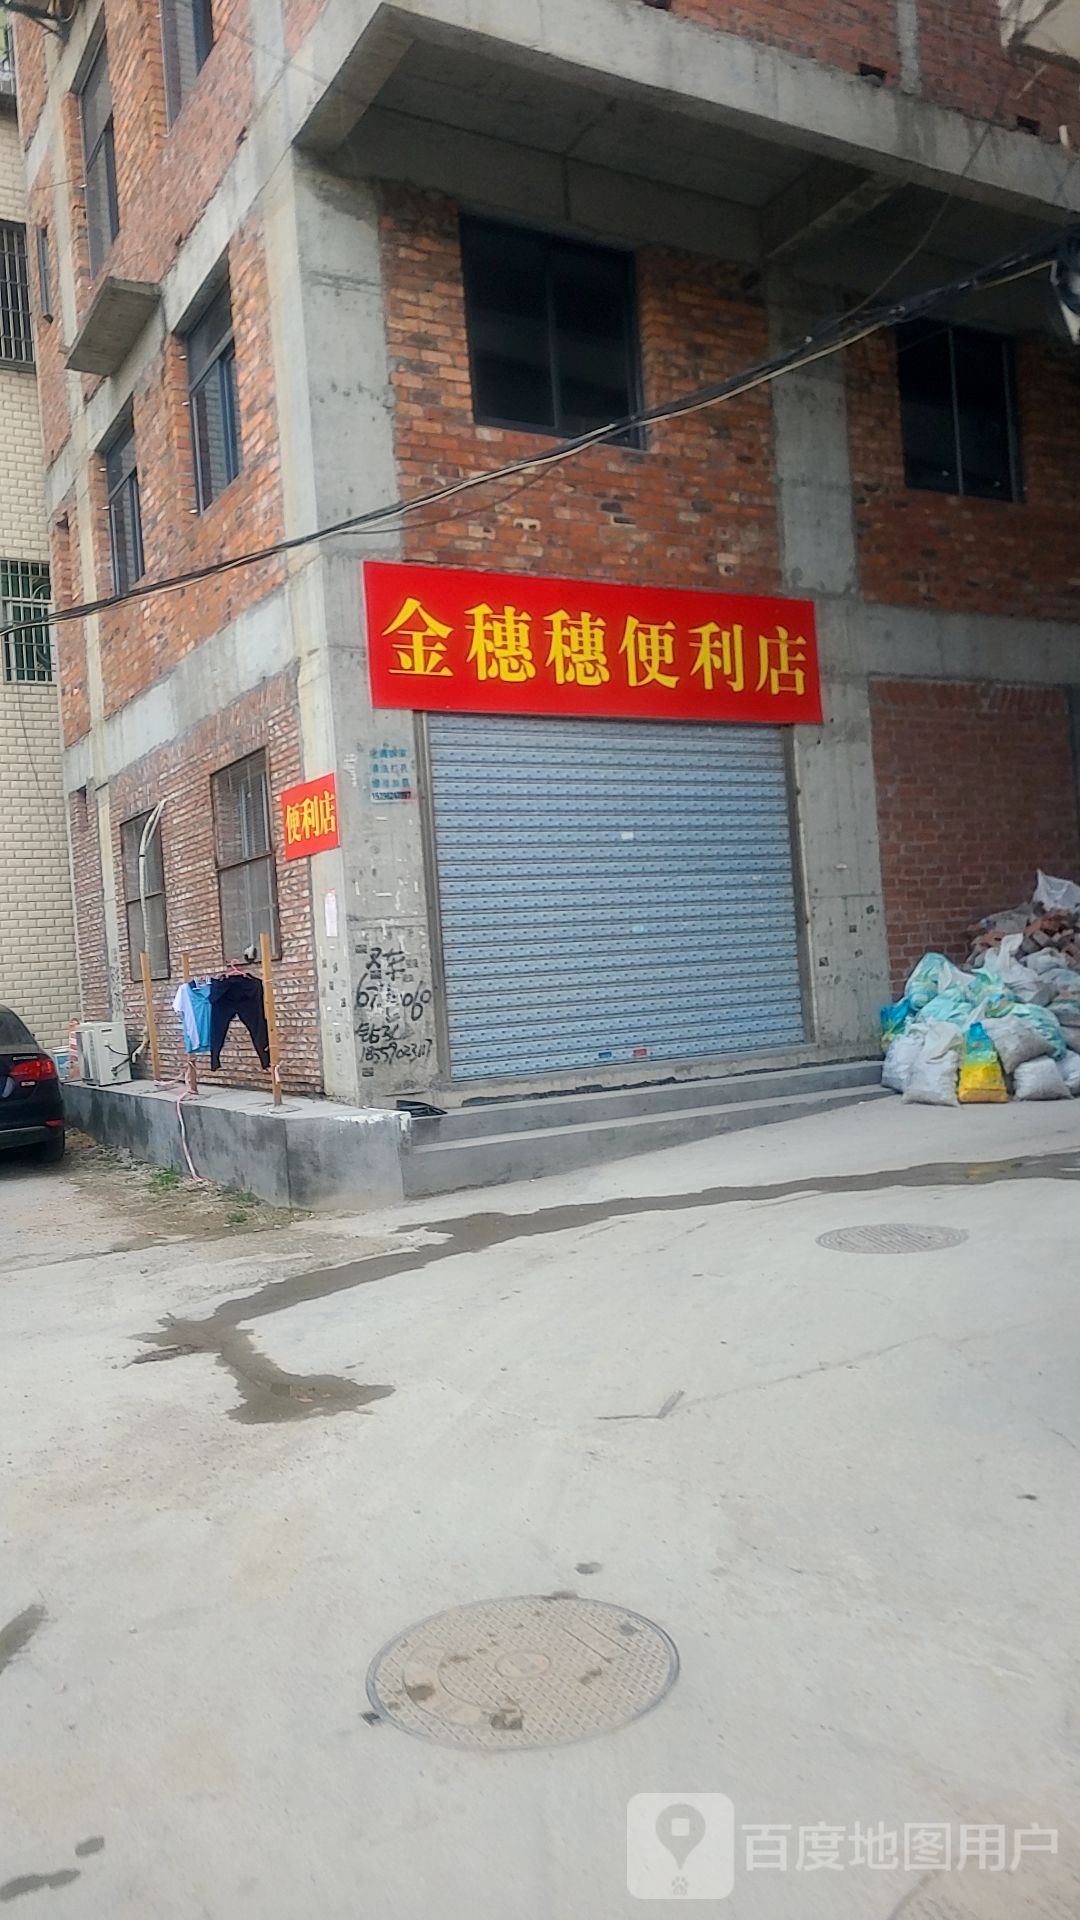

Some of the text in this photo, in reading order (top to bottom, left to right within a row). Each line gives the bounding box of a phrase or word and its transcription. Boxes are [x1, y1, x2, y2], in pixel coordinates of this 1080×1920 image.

[381, 597, 808, 696] 金穗穗便利店
[285, 790, 336, 845] 便利店
